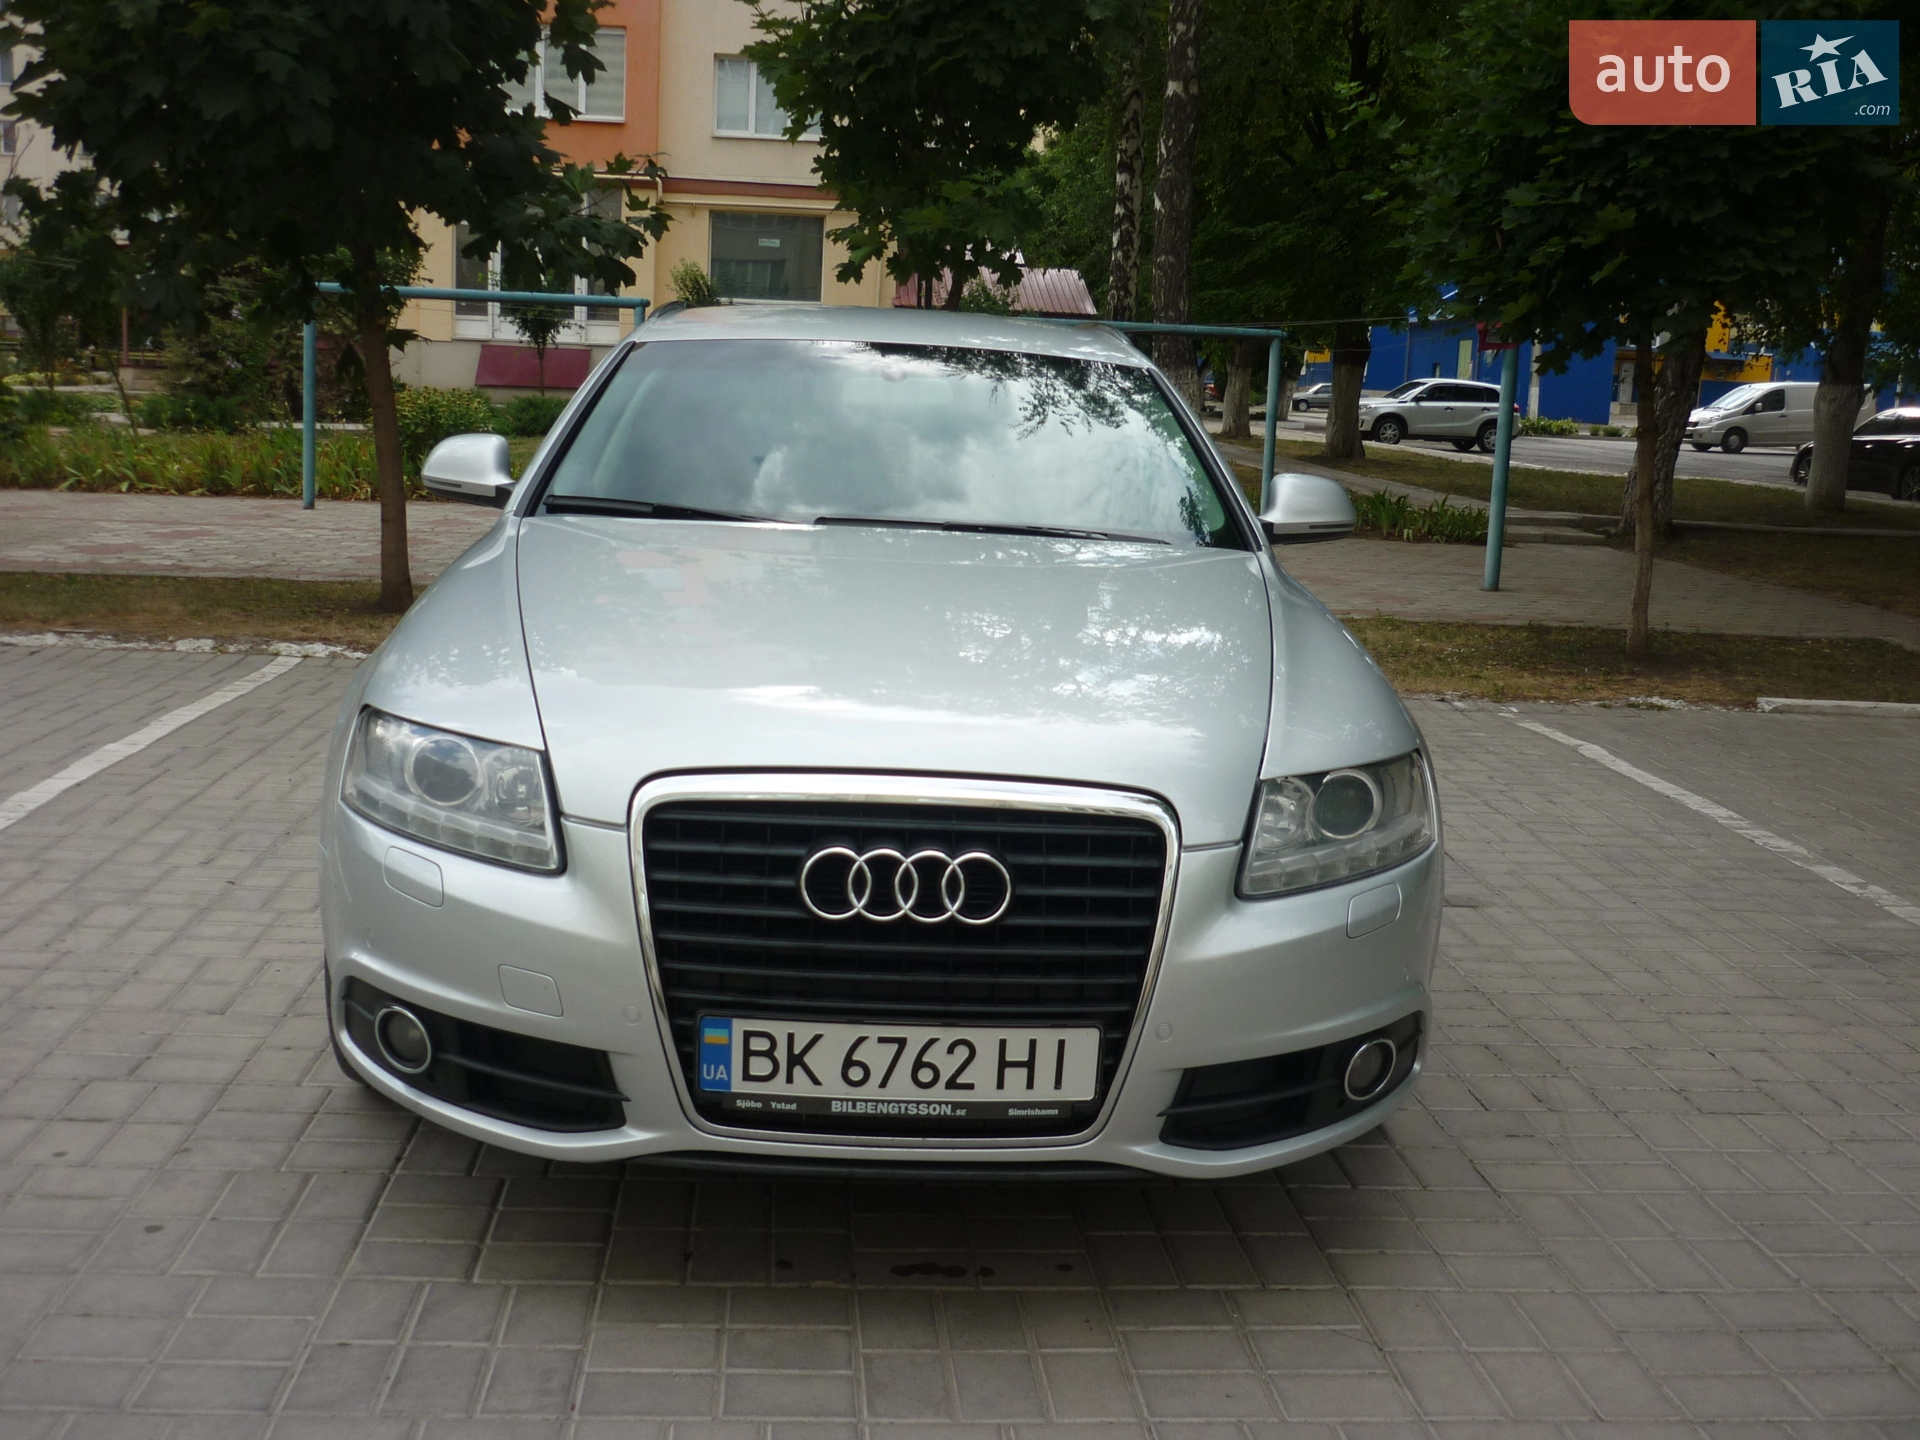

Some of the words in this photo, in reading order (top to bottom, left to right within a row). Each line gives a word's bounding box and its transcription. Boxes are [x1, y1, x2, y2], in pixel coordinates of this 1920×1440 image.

[742, 1029, 825, 1087] BK
[840, 1035, 977, 1091] 6762
[996, 1038, 1067, 1091] HI
[703, 1064, 728, 1081] UA
[735, 1099, 762, 1108] Sjöbo
[771, 1101, 797, 1110] Ystad
[1008, 1108, 1059, 1116] Simrishamn
